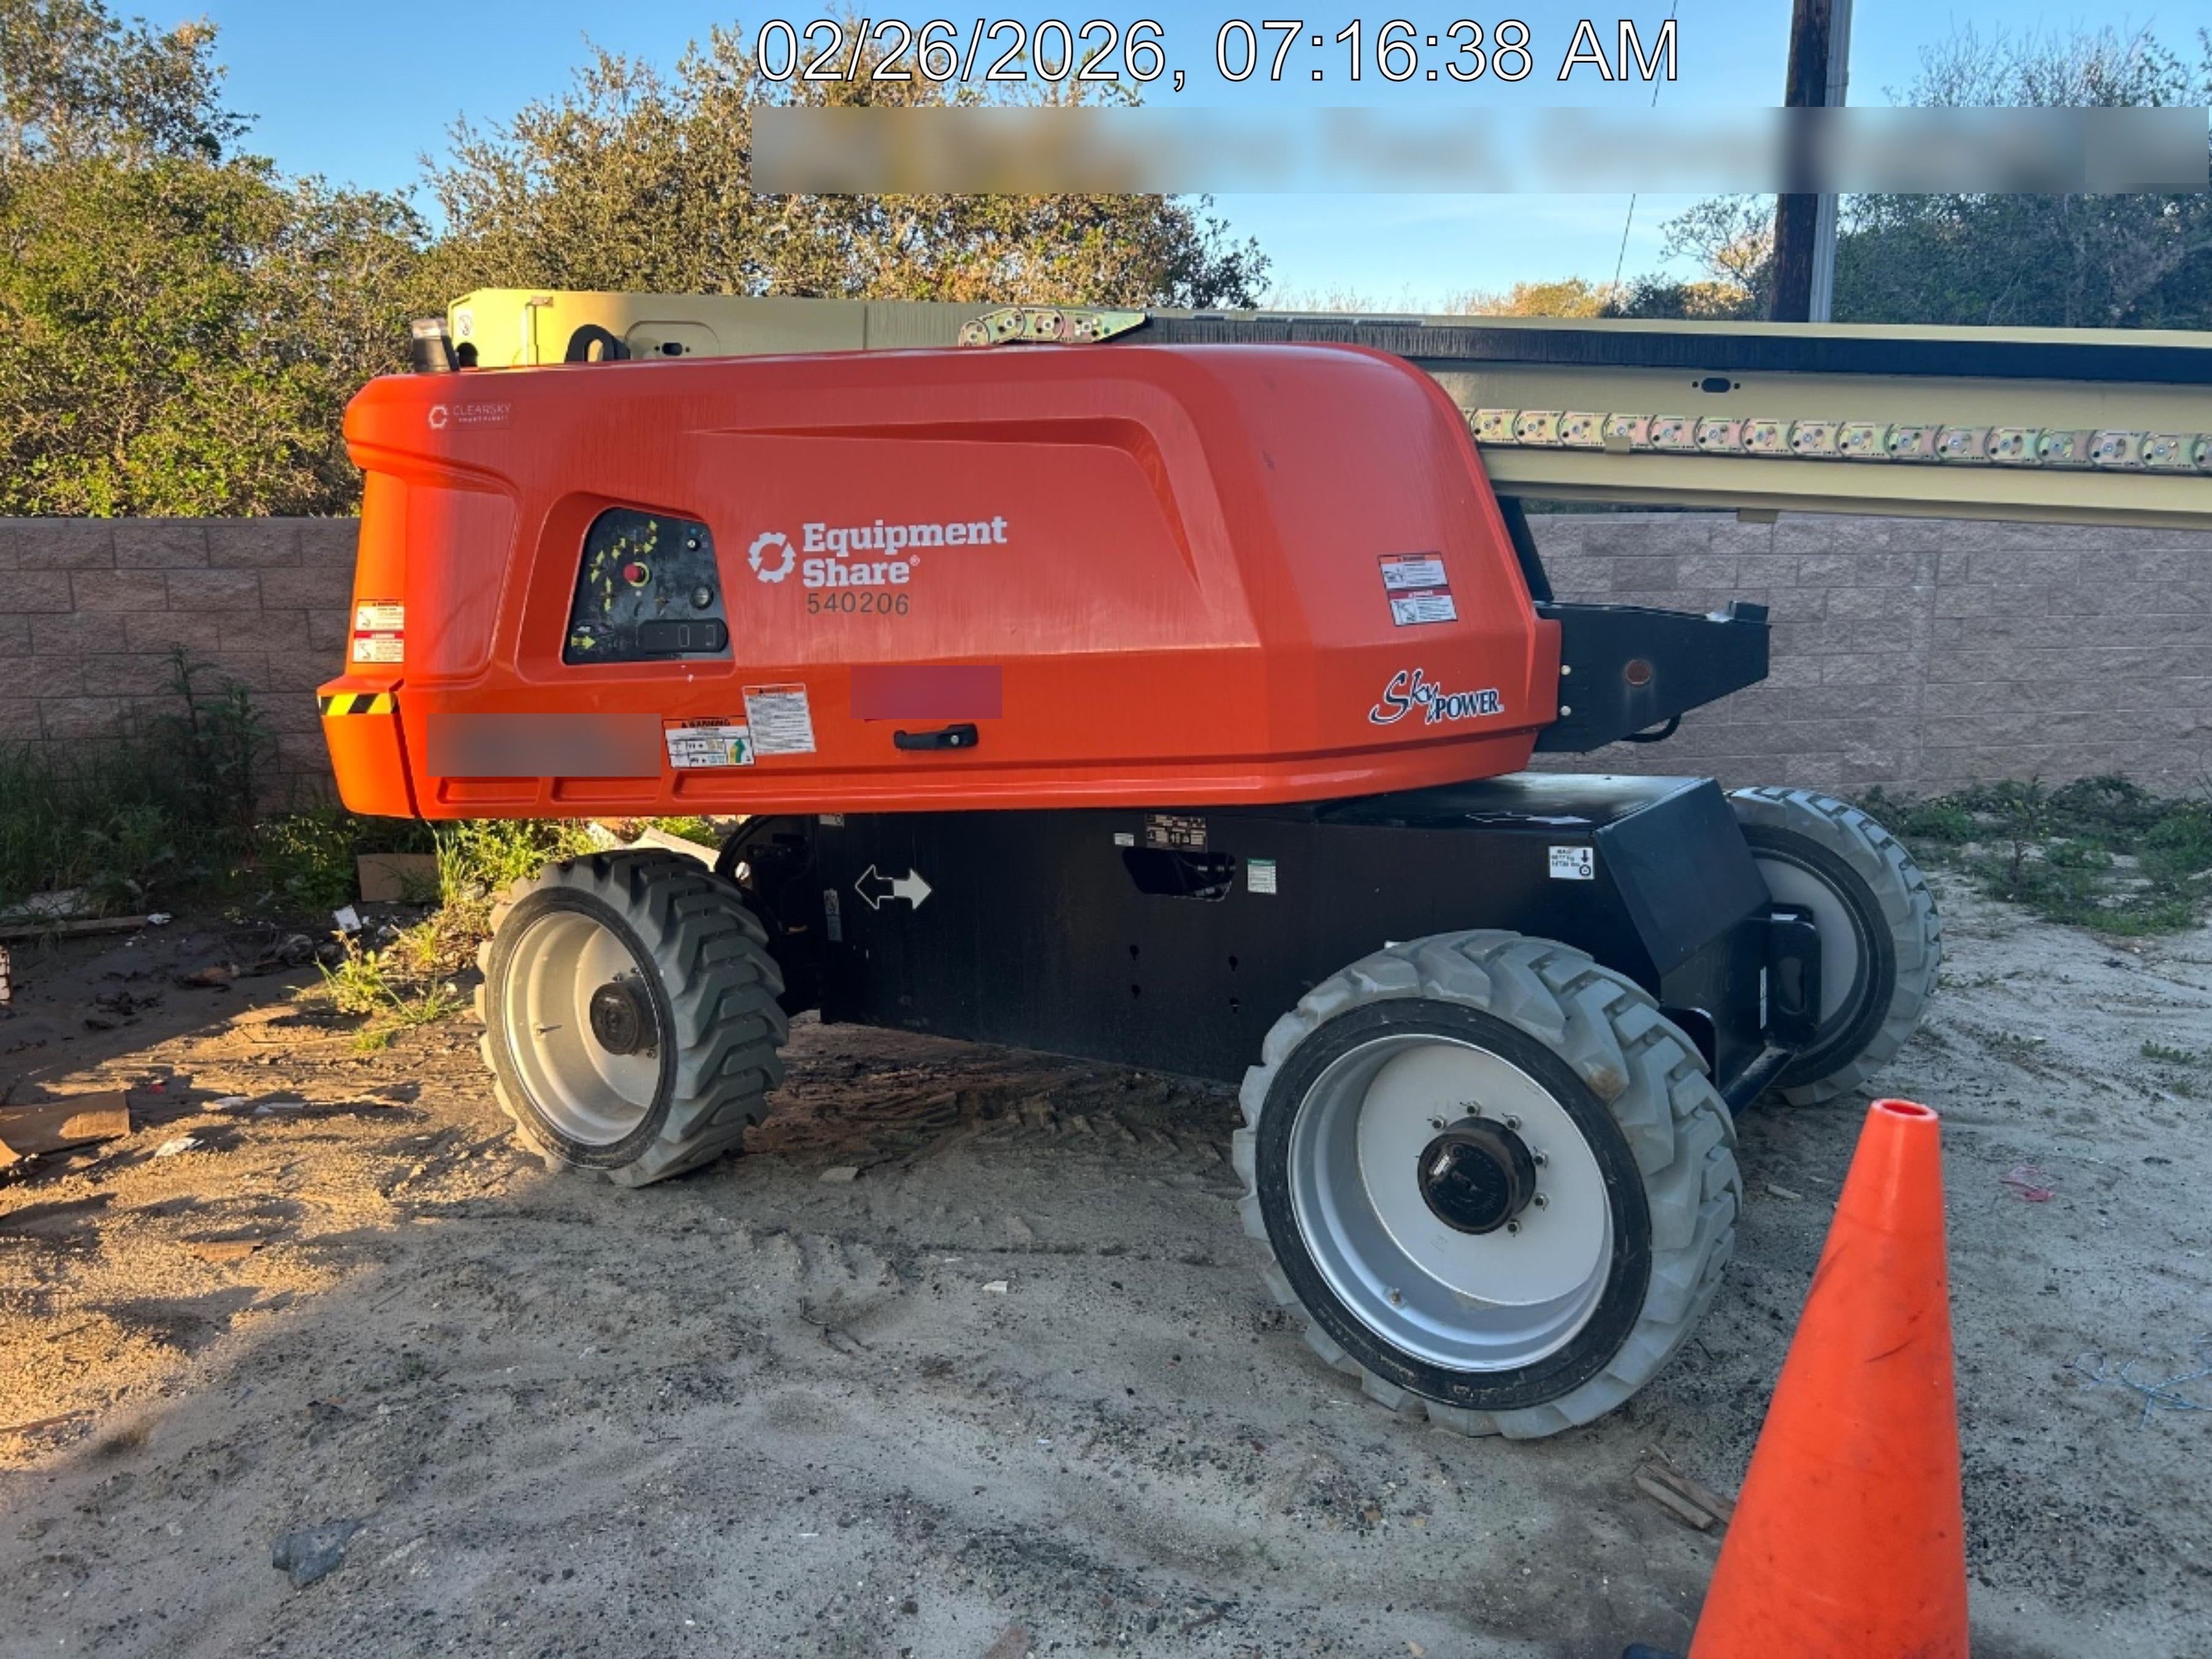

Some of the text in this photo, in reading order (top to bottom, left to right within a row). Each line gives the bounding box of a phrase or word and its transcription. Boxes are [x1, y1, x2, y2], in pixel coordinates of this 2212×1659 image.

[453, 403, 511, 415] CLEARSKY
[802, 516, 1008, 557] Equipment
[807, 592, 910, 615] 540206
[1433, 688, 1499, 721] POWER
